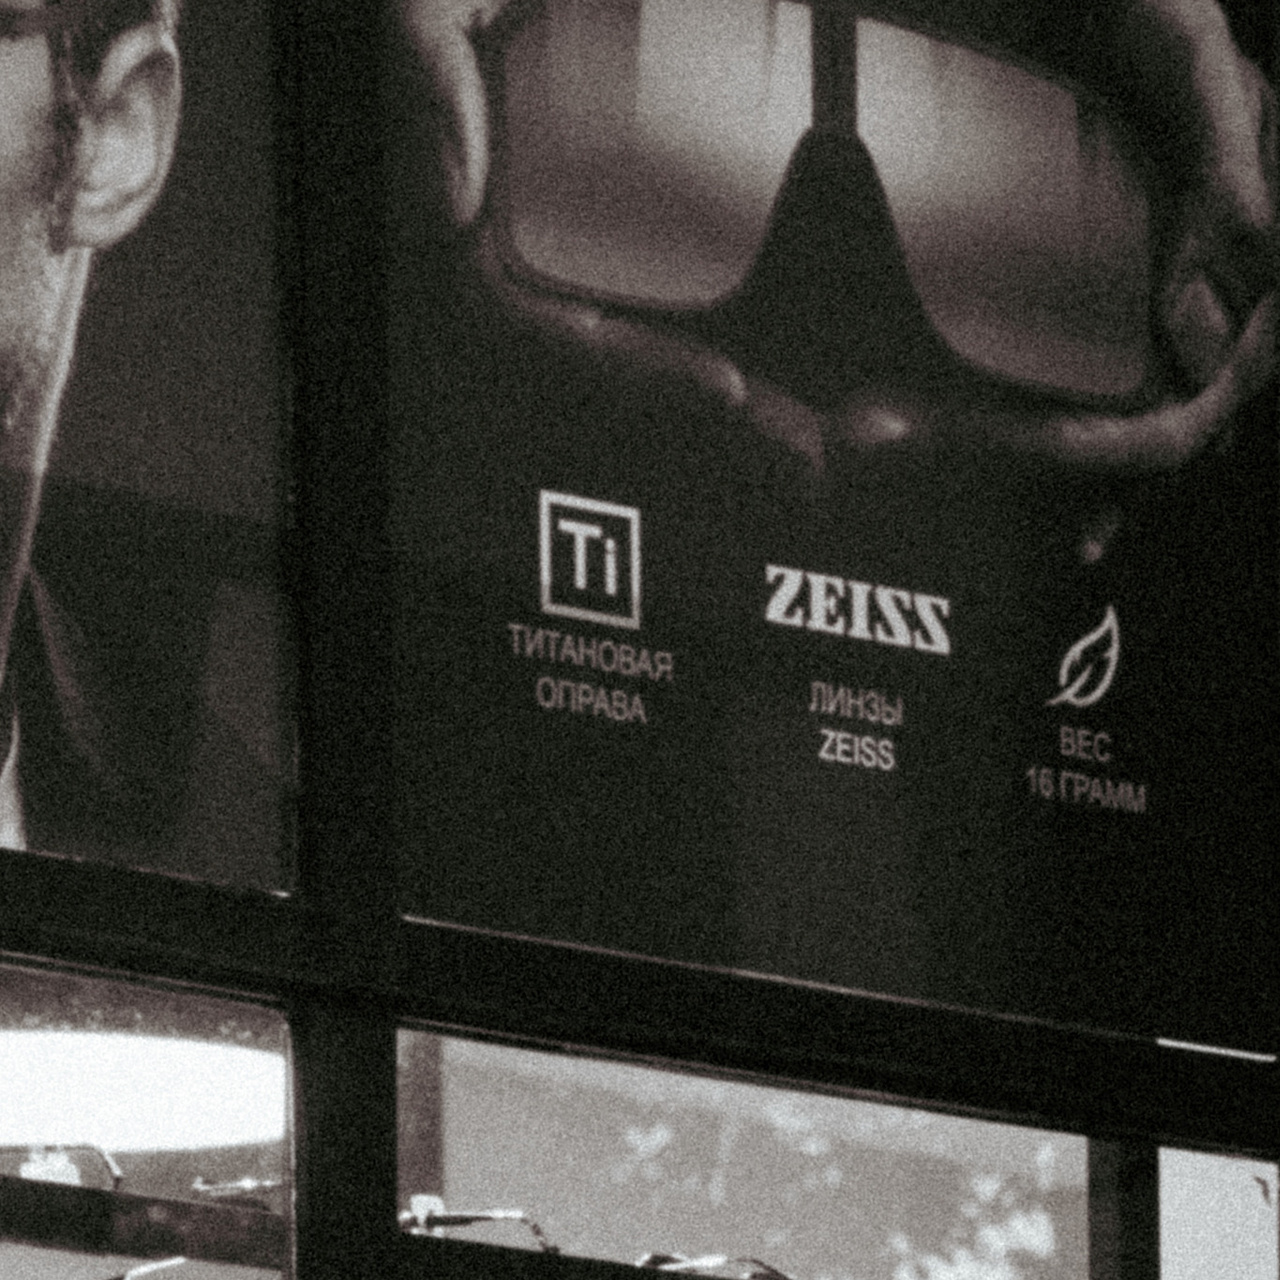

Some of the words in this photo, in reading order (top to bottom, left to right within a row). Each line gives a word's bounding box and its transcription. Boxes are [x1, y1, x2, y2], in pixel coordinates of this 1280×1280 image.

[557, 518, 618, 596] Ti
[764, 563, 951, 656] ZEISS
[507, 623, 674, 682] ТИТАНОВАЯ
[535, 676, 647, 725] ОПРАВА
[808, 679, 902, 726] ЛИНЗЫ
[817, 729, 896, 772] ZEISS
[1059, 725, 1111, 764] ВЕС
[1026, 766, 1055, 801] 16
[1059, 770, 1147, 813] ГРАММ
